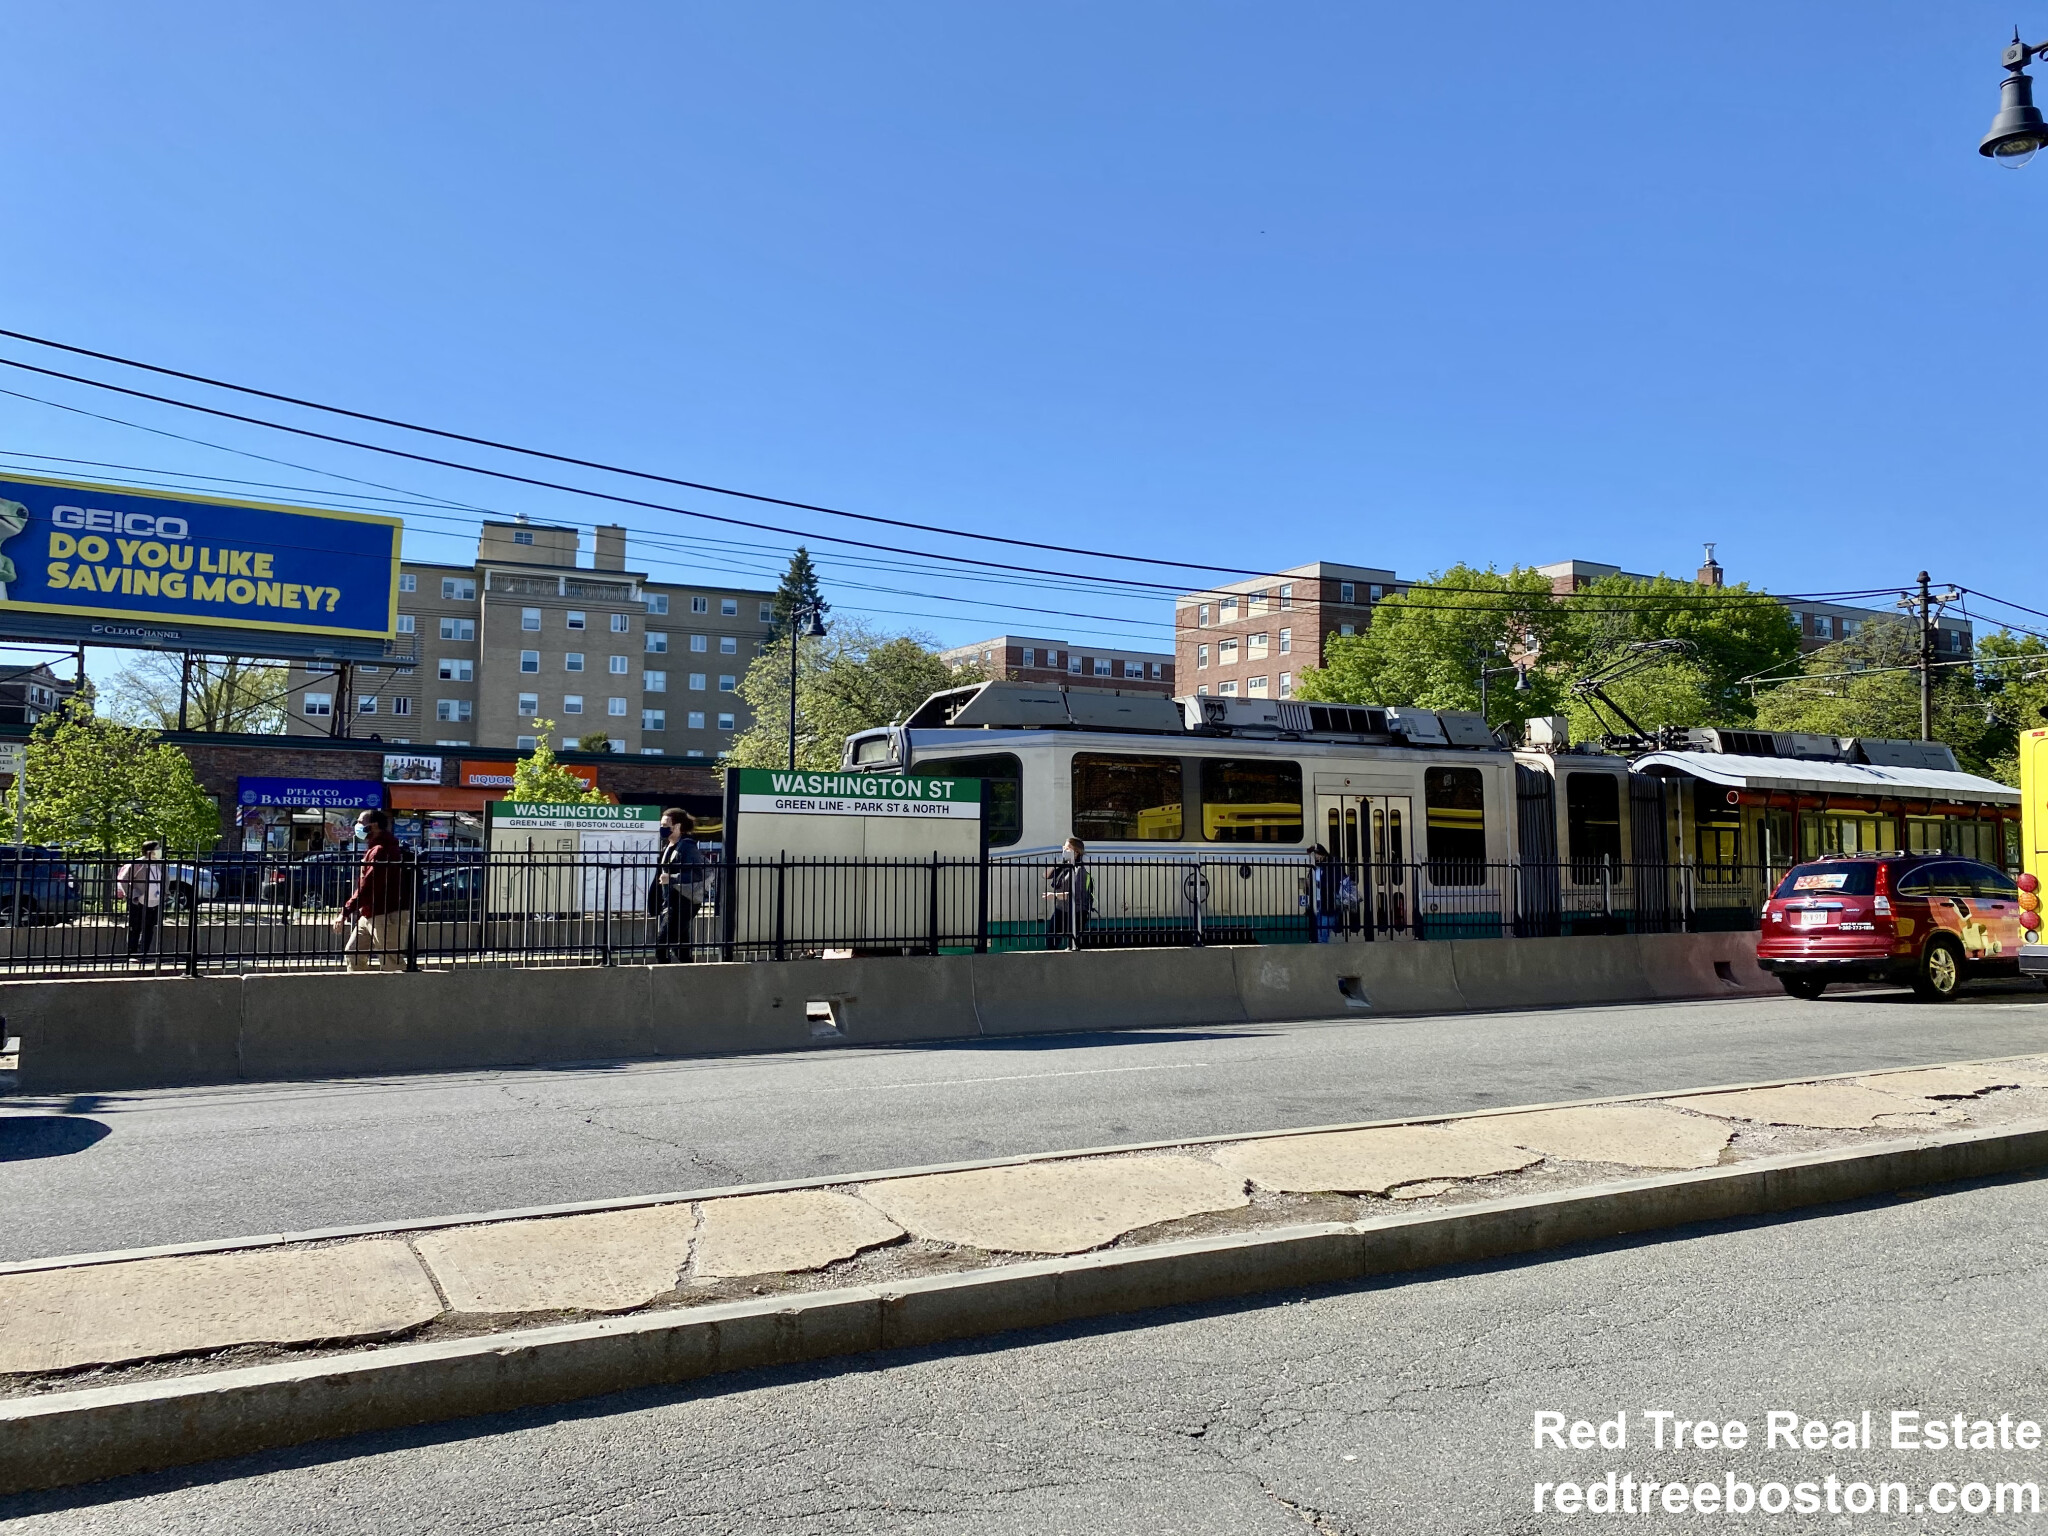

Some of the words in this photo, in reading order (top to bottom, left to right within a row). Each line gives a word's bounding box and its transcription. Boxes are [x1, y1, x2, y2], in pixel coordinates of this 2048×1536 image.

[52, 505, 190, 540] GEICO
[48, 532, 109, 562] DO
[117, 538, 194, 571] YOU
[199, 547, 274, 579] LIKE
[47, 561, 188, 600] SAVING
[193, 576, 341, 613] MONEY?
[469, 774, 514, 786] LIQUOR
[772, 774, 922, 798] WASHINGTON
[928, 781, 955, 799] ST
[261, 794, 321, 805] BARBER
[324, 797, 363, 806] SHOP
[286, 788, 340, 797] D'FLACCO
[514, 804, 619, 819] WASHINGTON
[623, 807, 642, 819] ST
[775, 798, 815, 811] GREEN
[819, 800, 844, 811] LINE
[854, 802, 883, 813] PARK
[886, 802, 900, 813] ST
[902, 804, 910, 814] &
[913, 803, 949, 814] NORTH
[509, 819, 537, 827] GREEN
[539, 820, 557, 828] LINE
[563, 820, 575, 829] (B)
[576, 821, 608, 829] BOSTON
